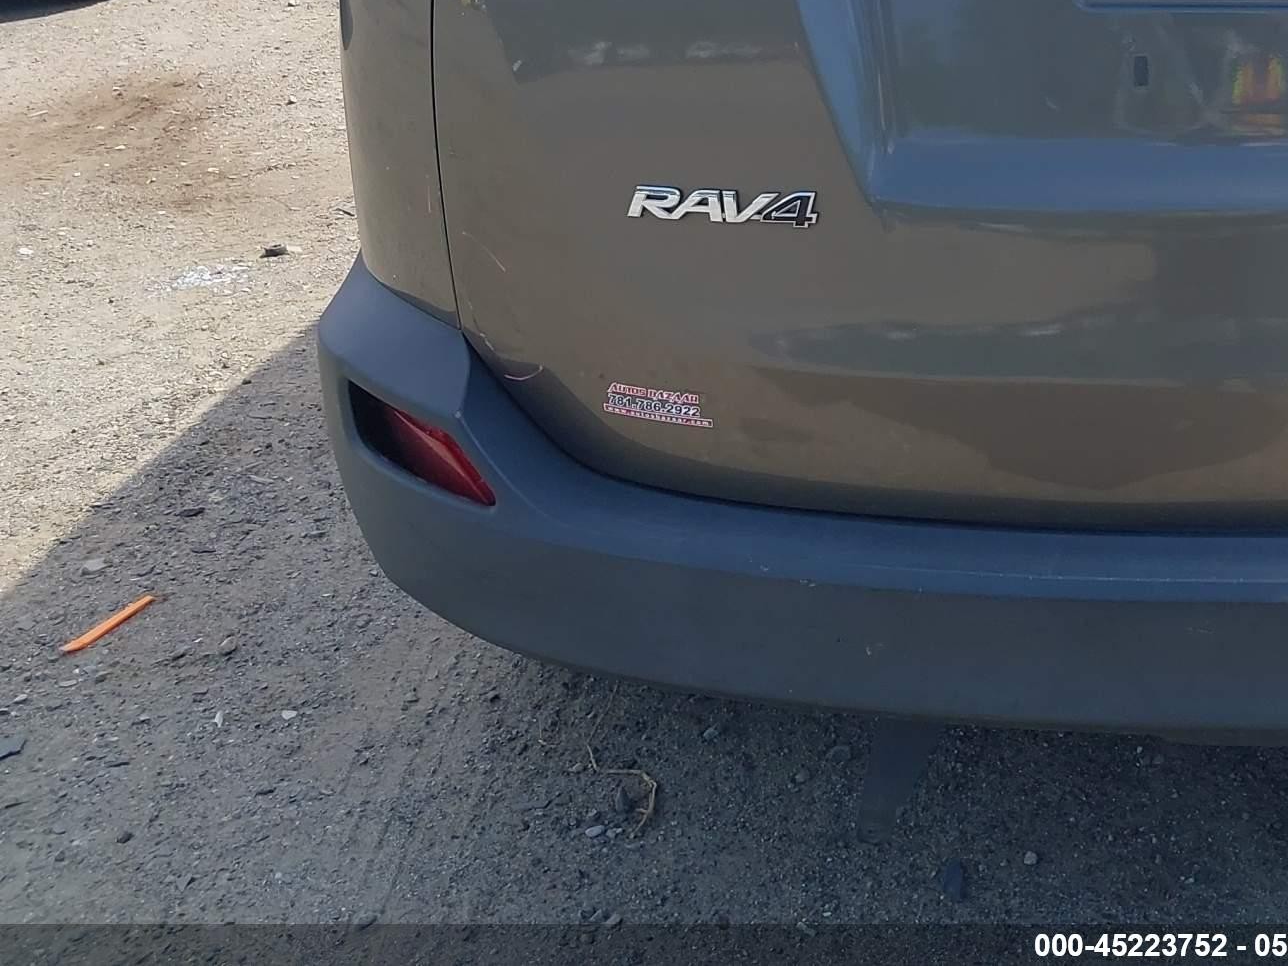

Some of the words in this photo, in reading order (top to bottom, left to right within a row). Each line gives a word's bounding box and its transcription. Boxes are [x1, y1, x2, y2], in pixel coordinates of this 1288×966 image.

[627, 185, 819, 228] RAV4
[608, 382, 647, 397] AUTOS
[608, 393, 701, 417] 781.786.2922
